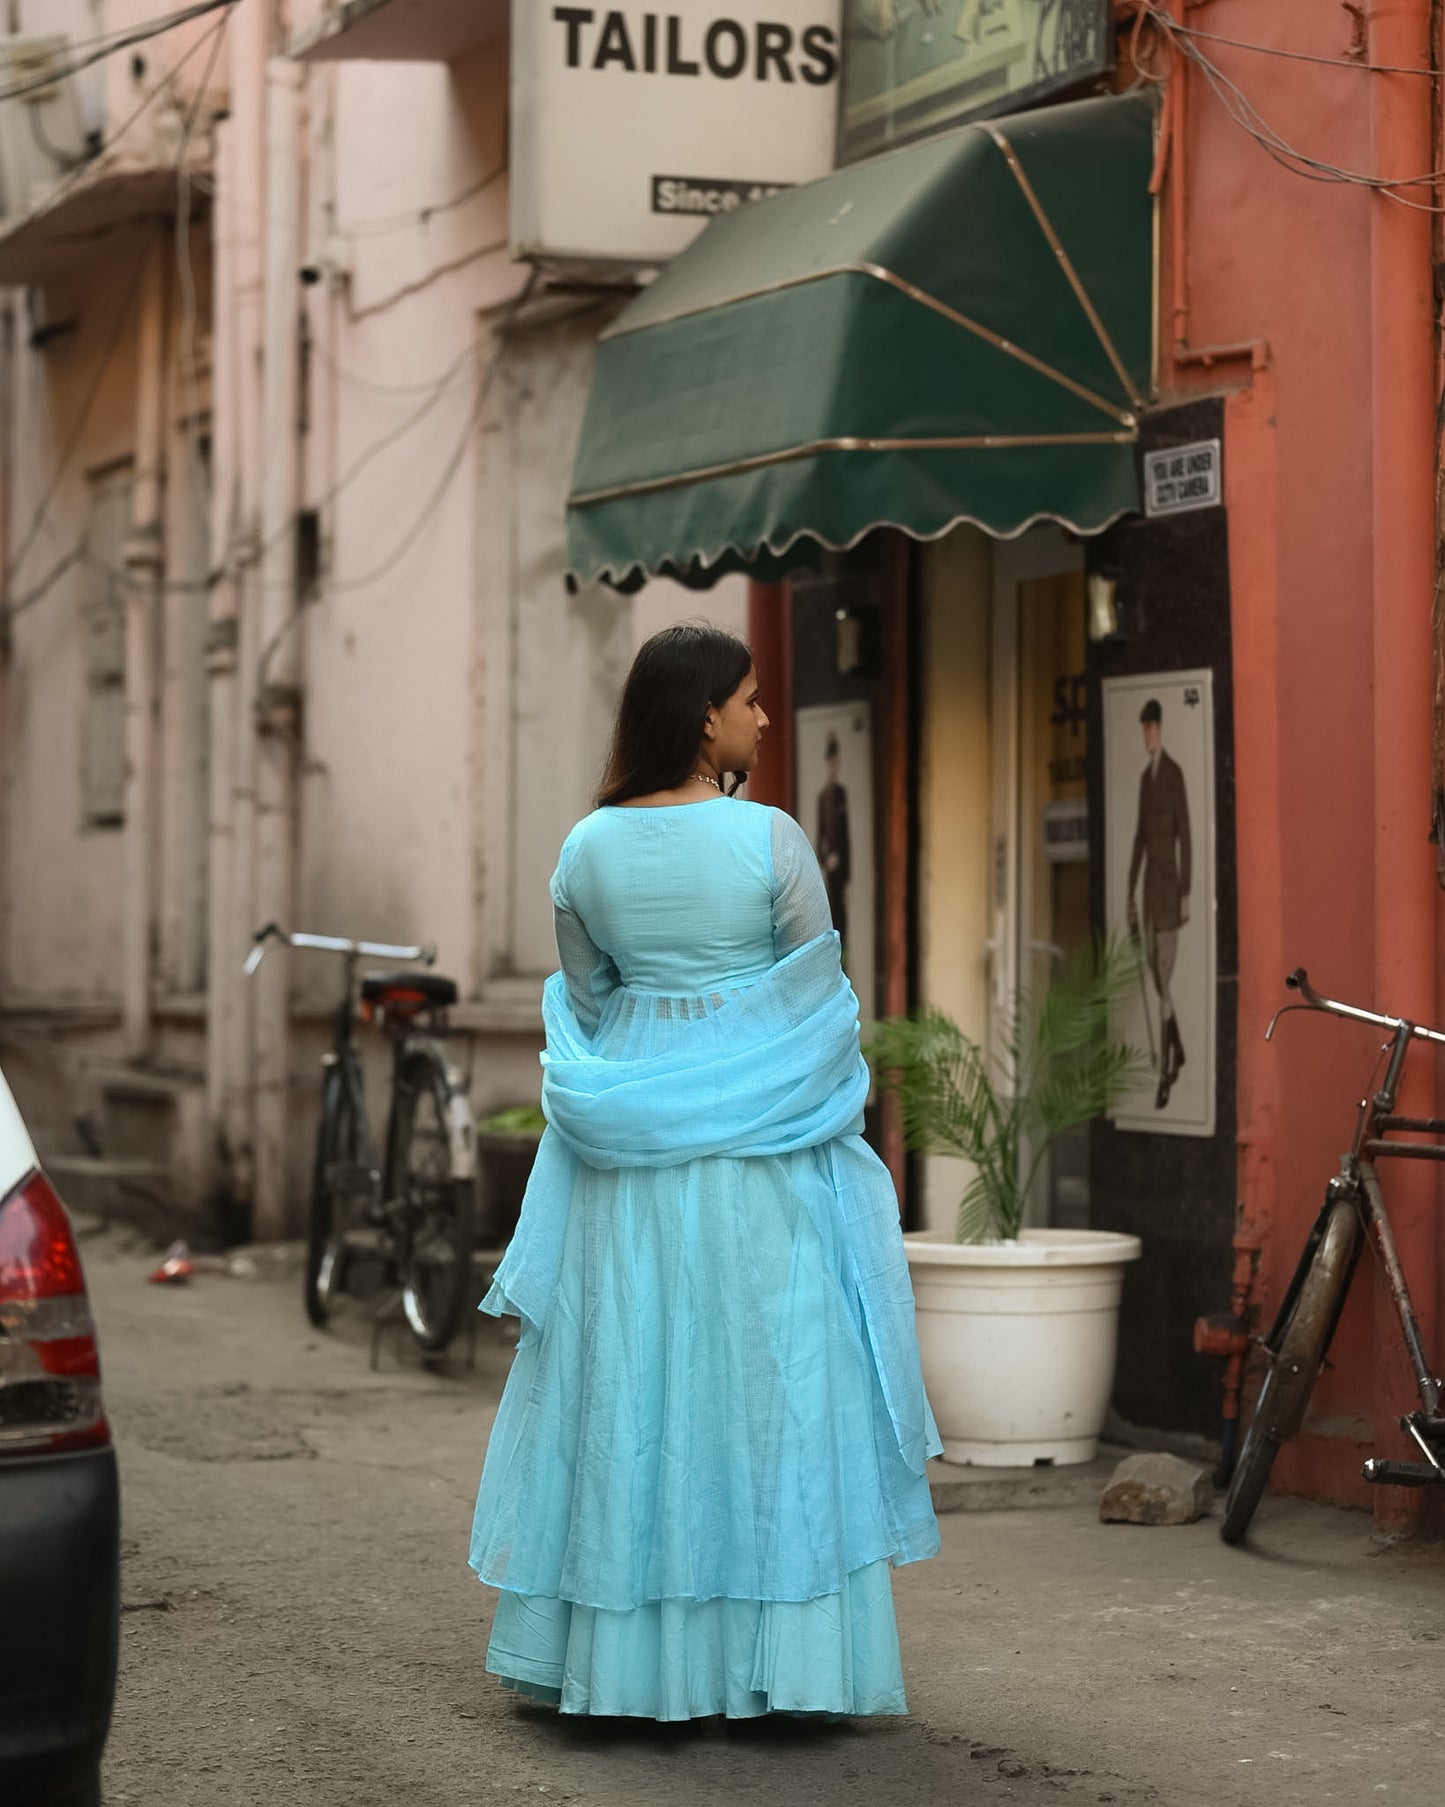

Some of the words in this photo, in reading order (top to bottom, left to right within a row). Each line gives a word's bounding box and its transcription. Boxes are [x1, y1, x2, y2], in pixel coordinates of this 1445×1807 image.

[553, 7, 837, 85] TAILORS
[657, 179, 740, 212] Since
[1170, 457, 1185, 478] ARE
[1187, 452, 1212, 475] UNDER
[1156, 482, 1177, 504] CCTV
[1178, 477, 1209, 500] CAMERA
